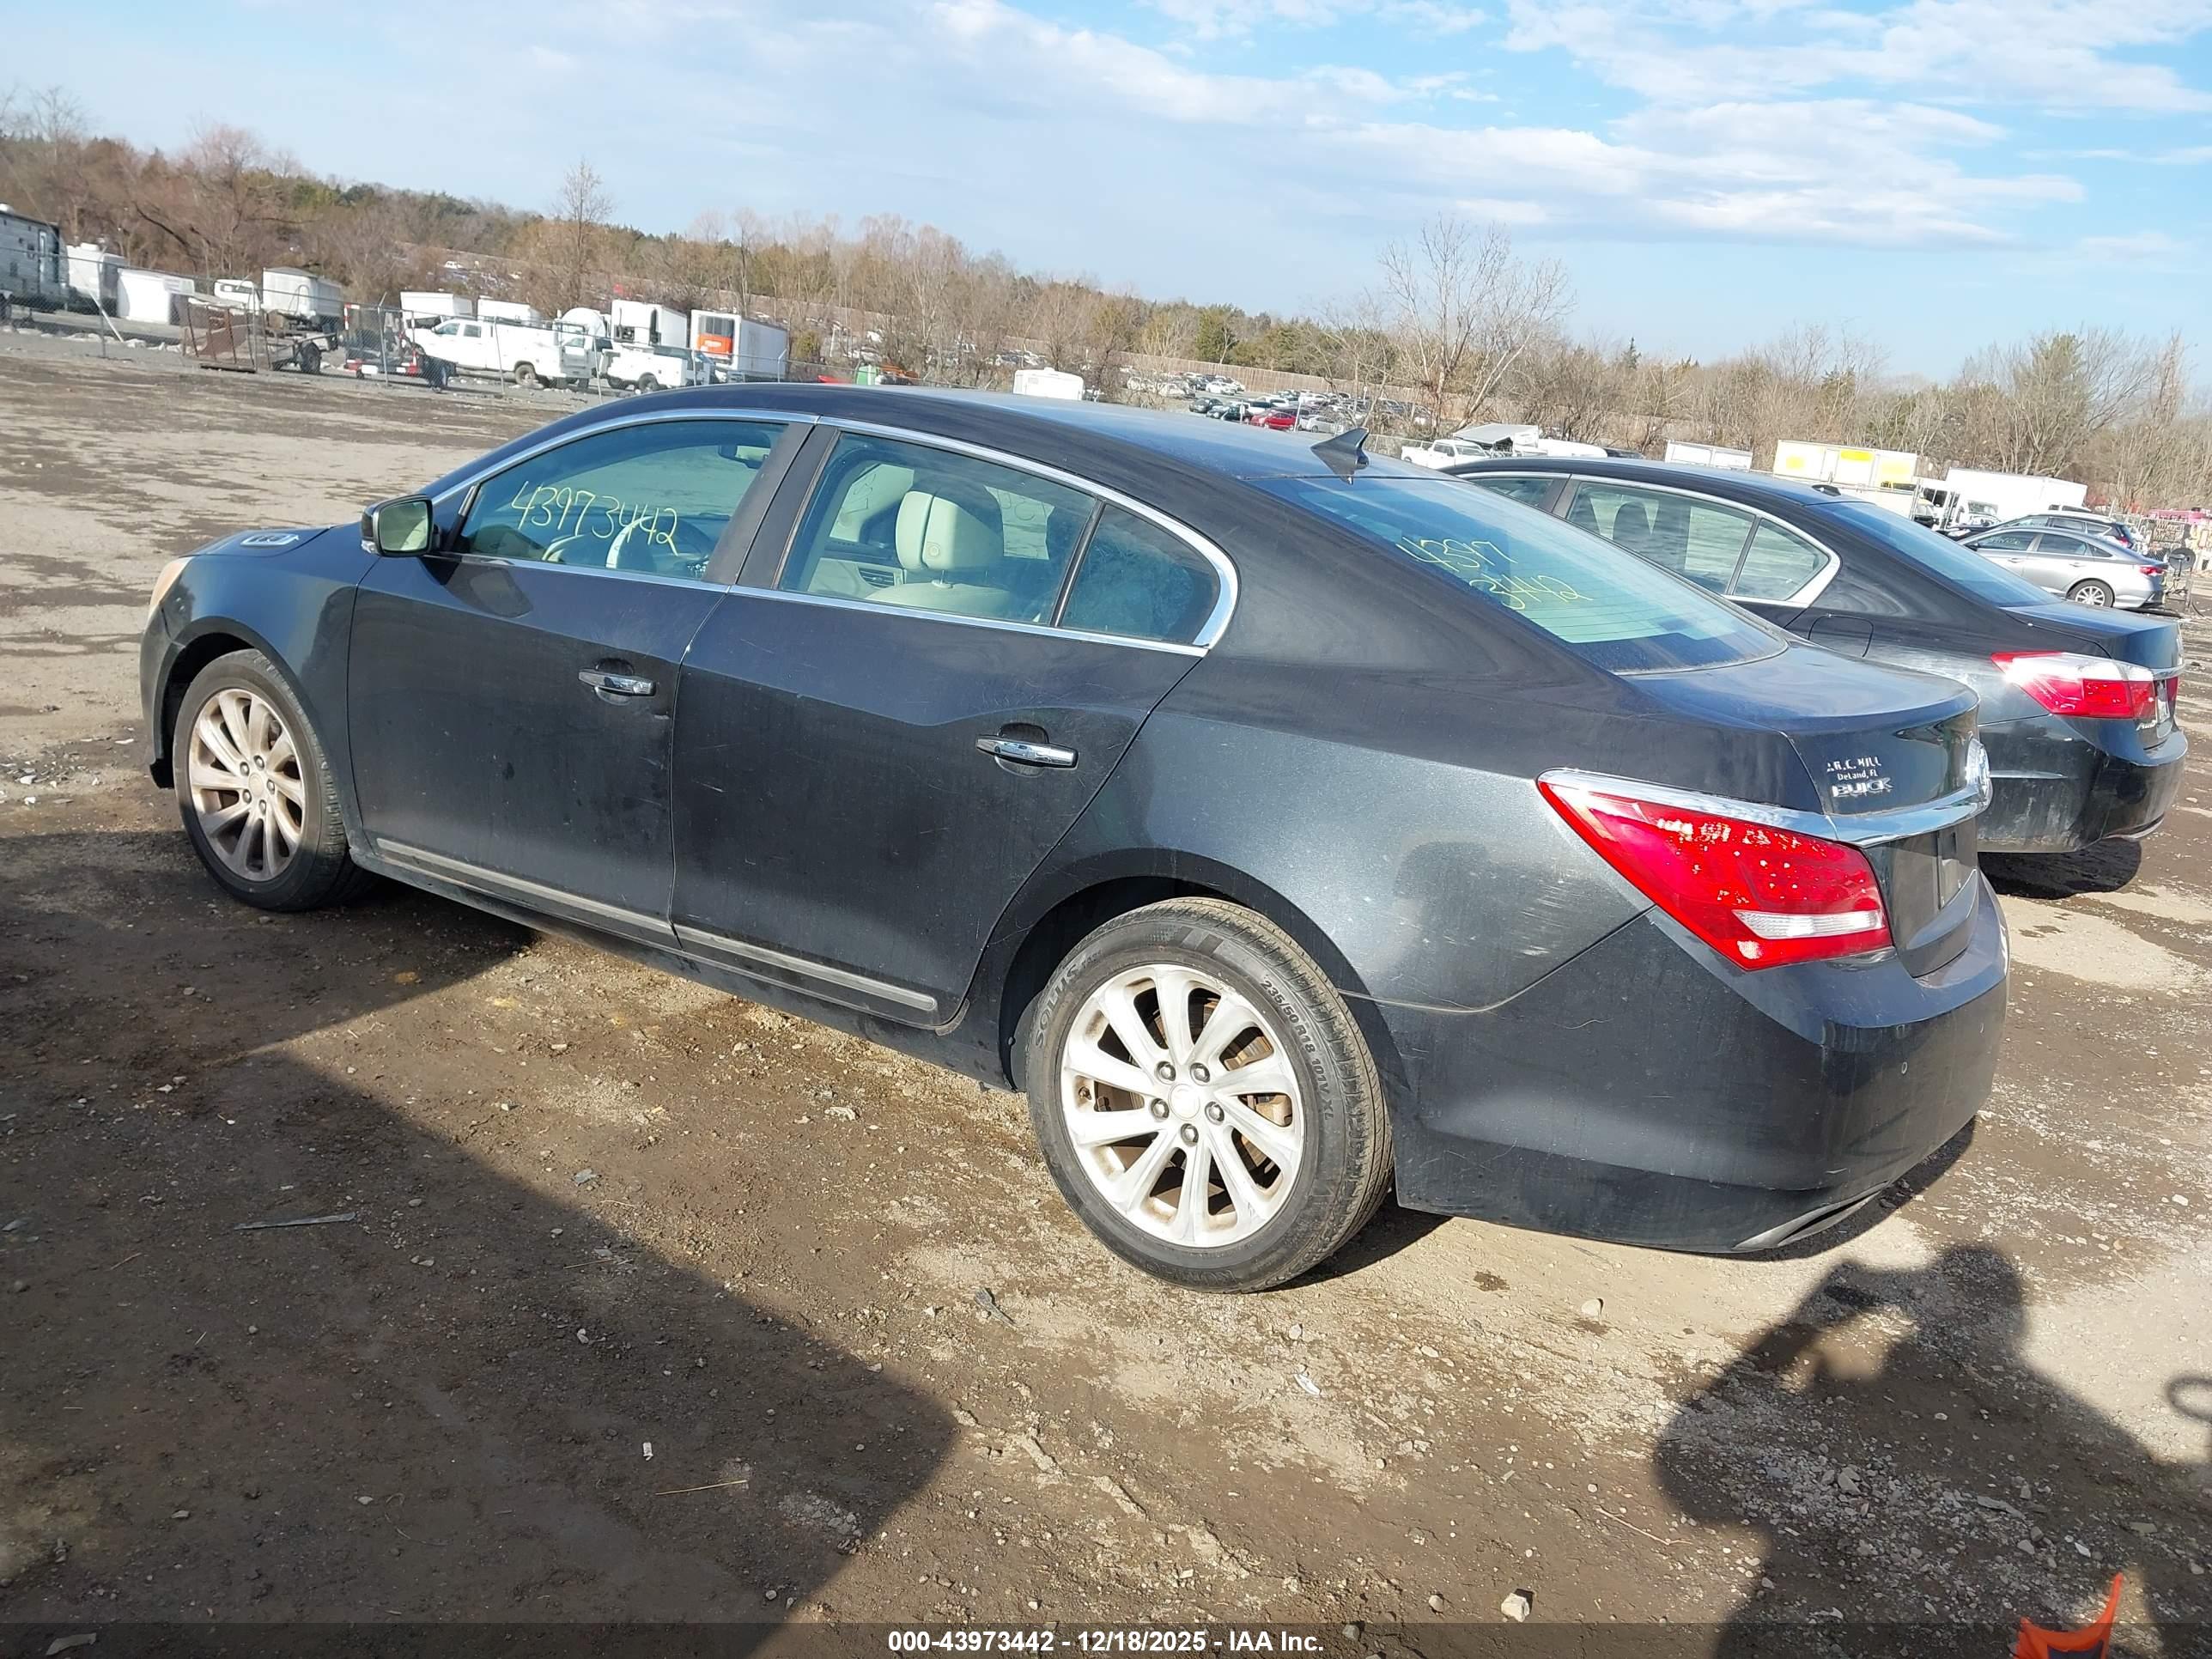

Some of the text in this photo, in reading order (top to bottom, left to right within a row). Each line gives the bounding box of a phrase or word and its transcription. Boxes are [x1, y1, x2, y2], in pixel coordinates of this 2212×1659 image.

[511, 480, 678, 556] 43973442
[1832, 777, 1894, 798] BUICK
[1035, 963, 1079, 1048] SOLUS
[1323, 1098, 1334, 1121] XL
